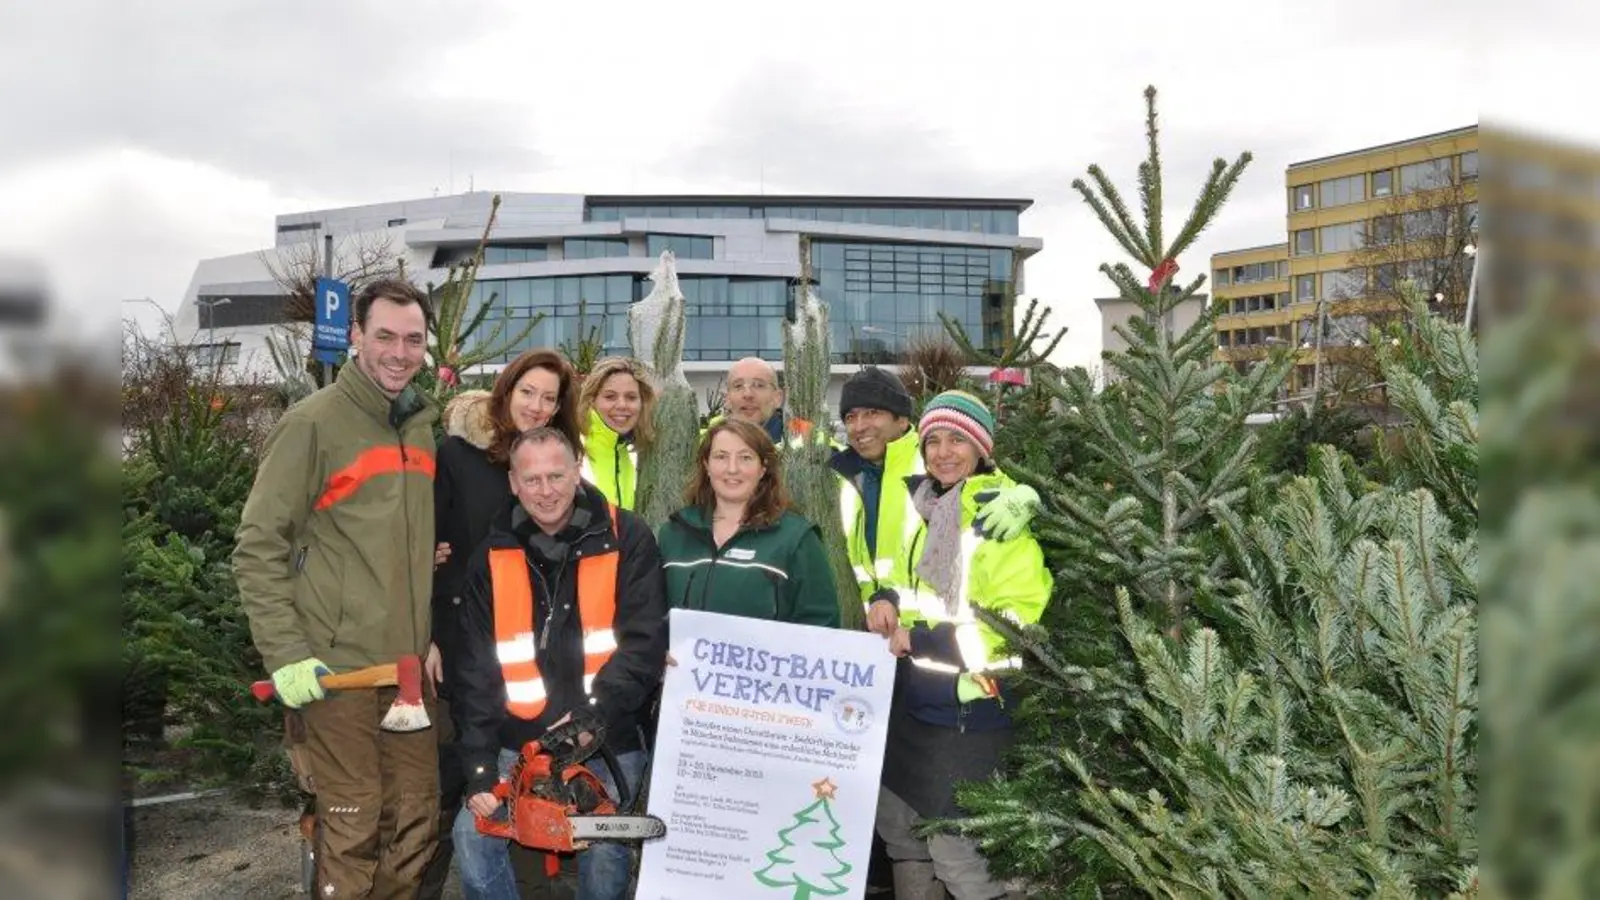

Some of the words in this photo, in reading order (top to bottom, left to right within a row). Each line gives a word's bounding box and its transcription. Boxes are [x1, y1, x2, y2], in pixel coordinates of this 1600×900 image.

[326, 289, 340, 319] P
[694, 638, 876, 687] CHRISTBAUM
[691, 669, 835, 712] VERKAUF
